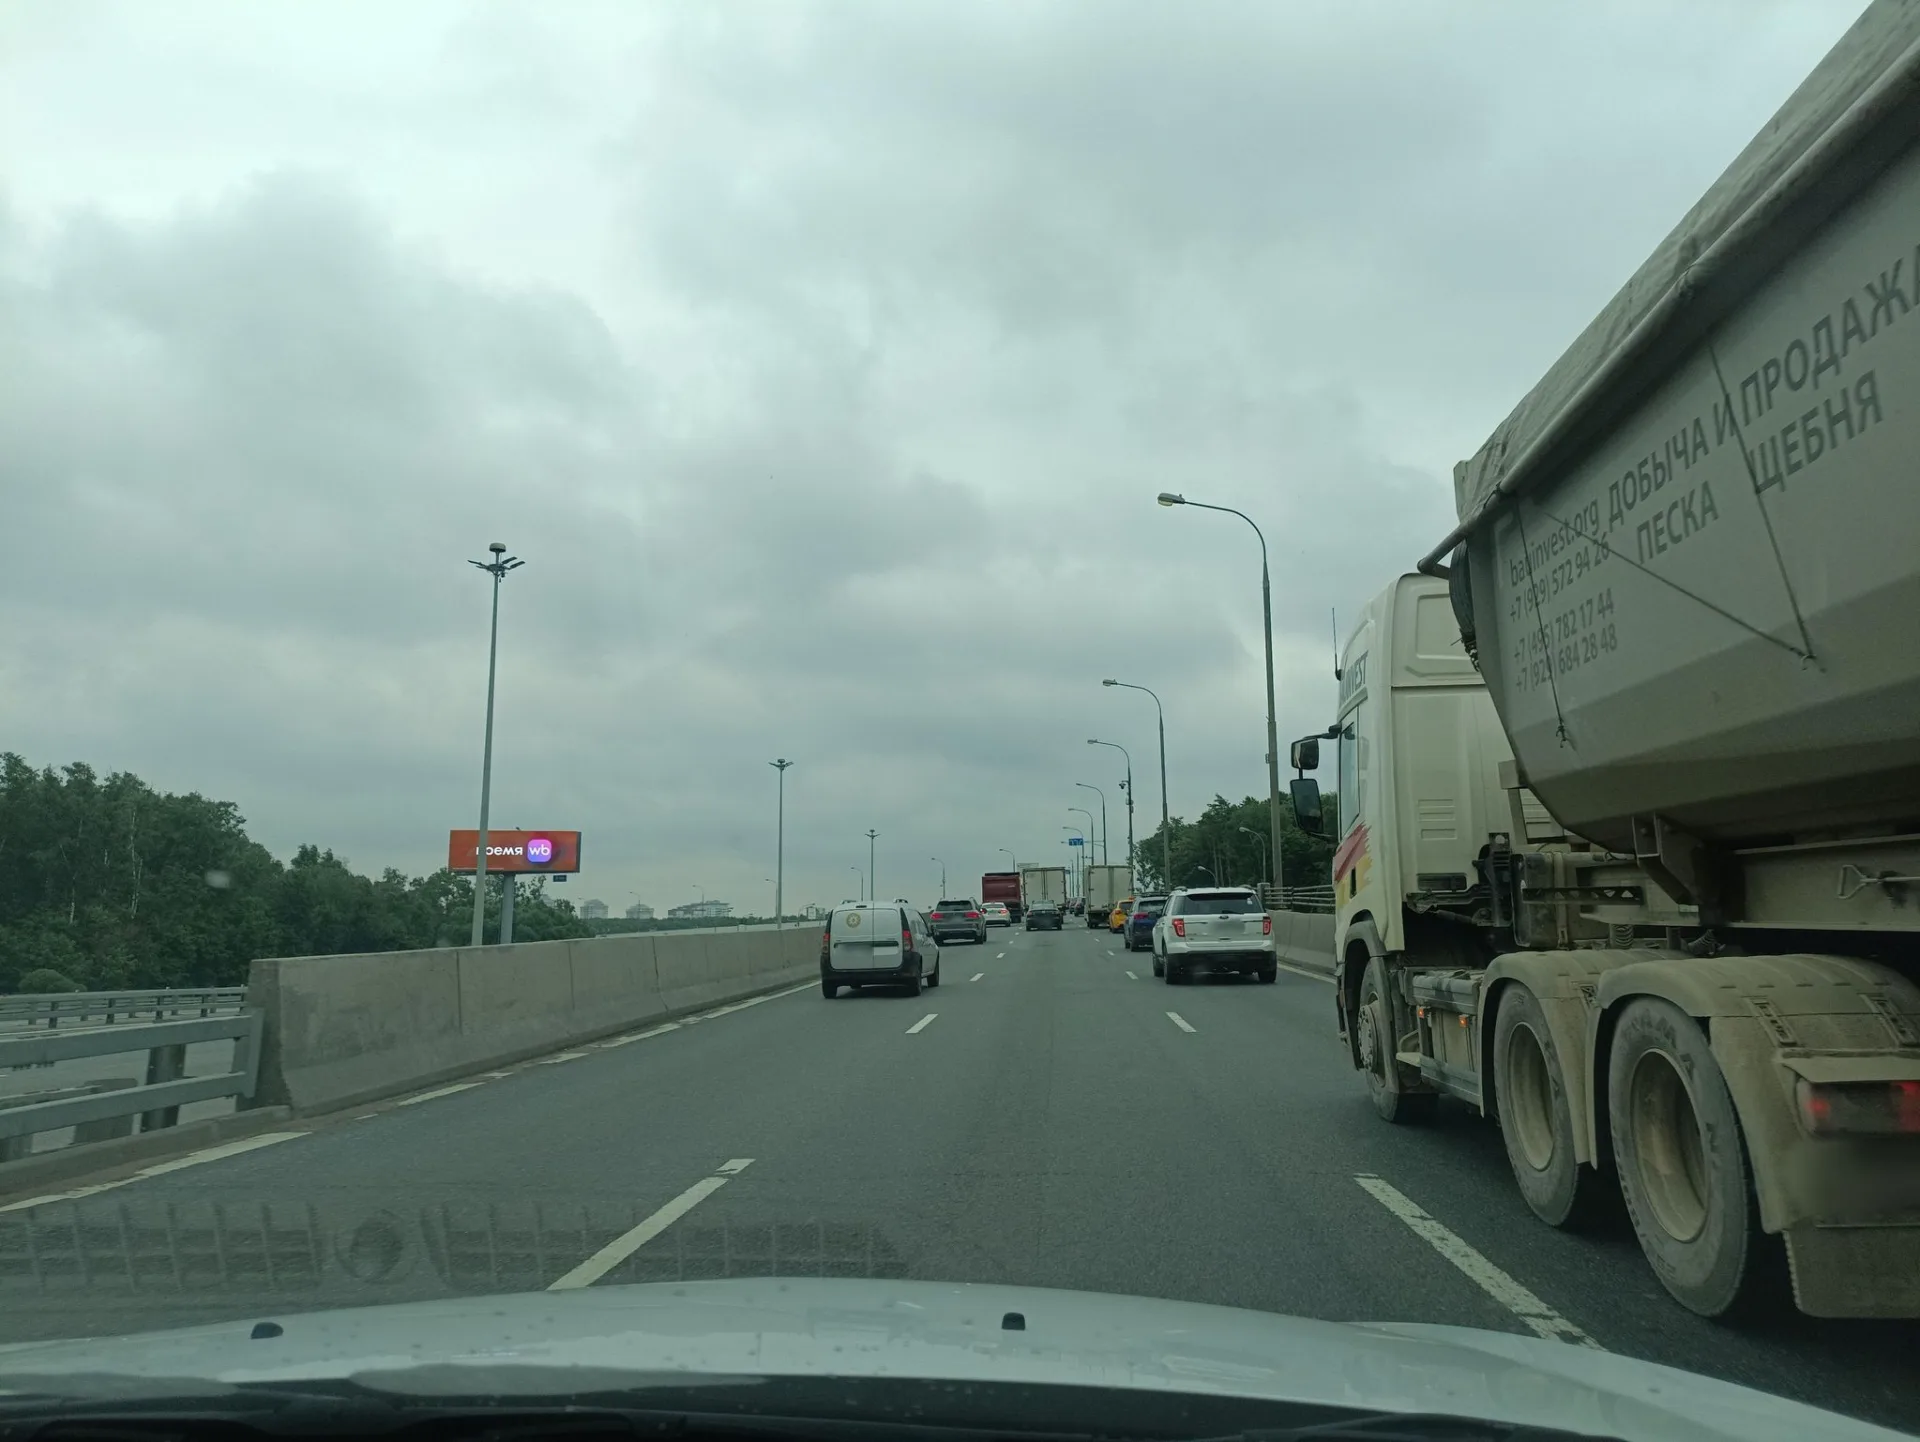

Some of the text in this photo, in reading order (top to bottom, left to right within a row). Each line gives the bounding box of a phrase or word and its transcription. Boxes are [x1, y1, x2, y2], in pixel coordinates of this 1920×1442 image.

[1609, 243, 1920, 532] ДОБЫЧА И ПРОДАЖ
[1636, 369, 1884, 566] ПЕСКА ЩЕБНЯ
[1510, 596, 1521, 623] +7
[1552, 558, 1575, 597] 572
[1575, 546, 1592, 580] 94
[1514, 638, 1525, 665] +7
[1556, 607, 1578, 643] 782
[1580, 597, 1594, 628] 17
[1597, 587, 1615, 619] 44
[1516, 666, 1528, 694] +7
[1558, 641, 1580, 675] 684
[1582, 632, 1598, 664] 28
[1600, 622, 1618, 655] 48
[476, 844, 550, 855] ремя wb
